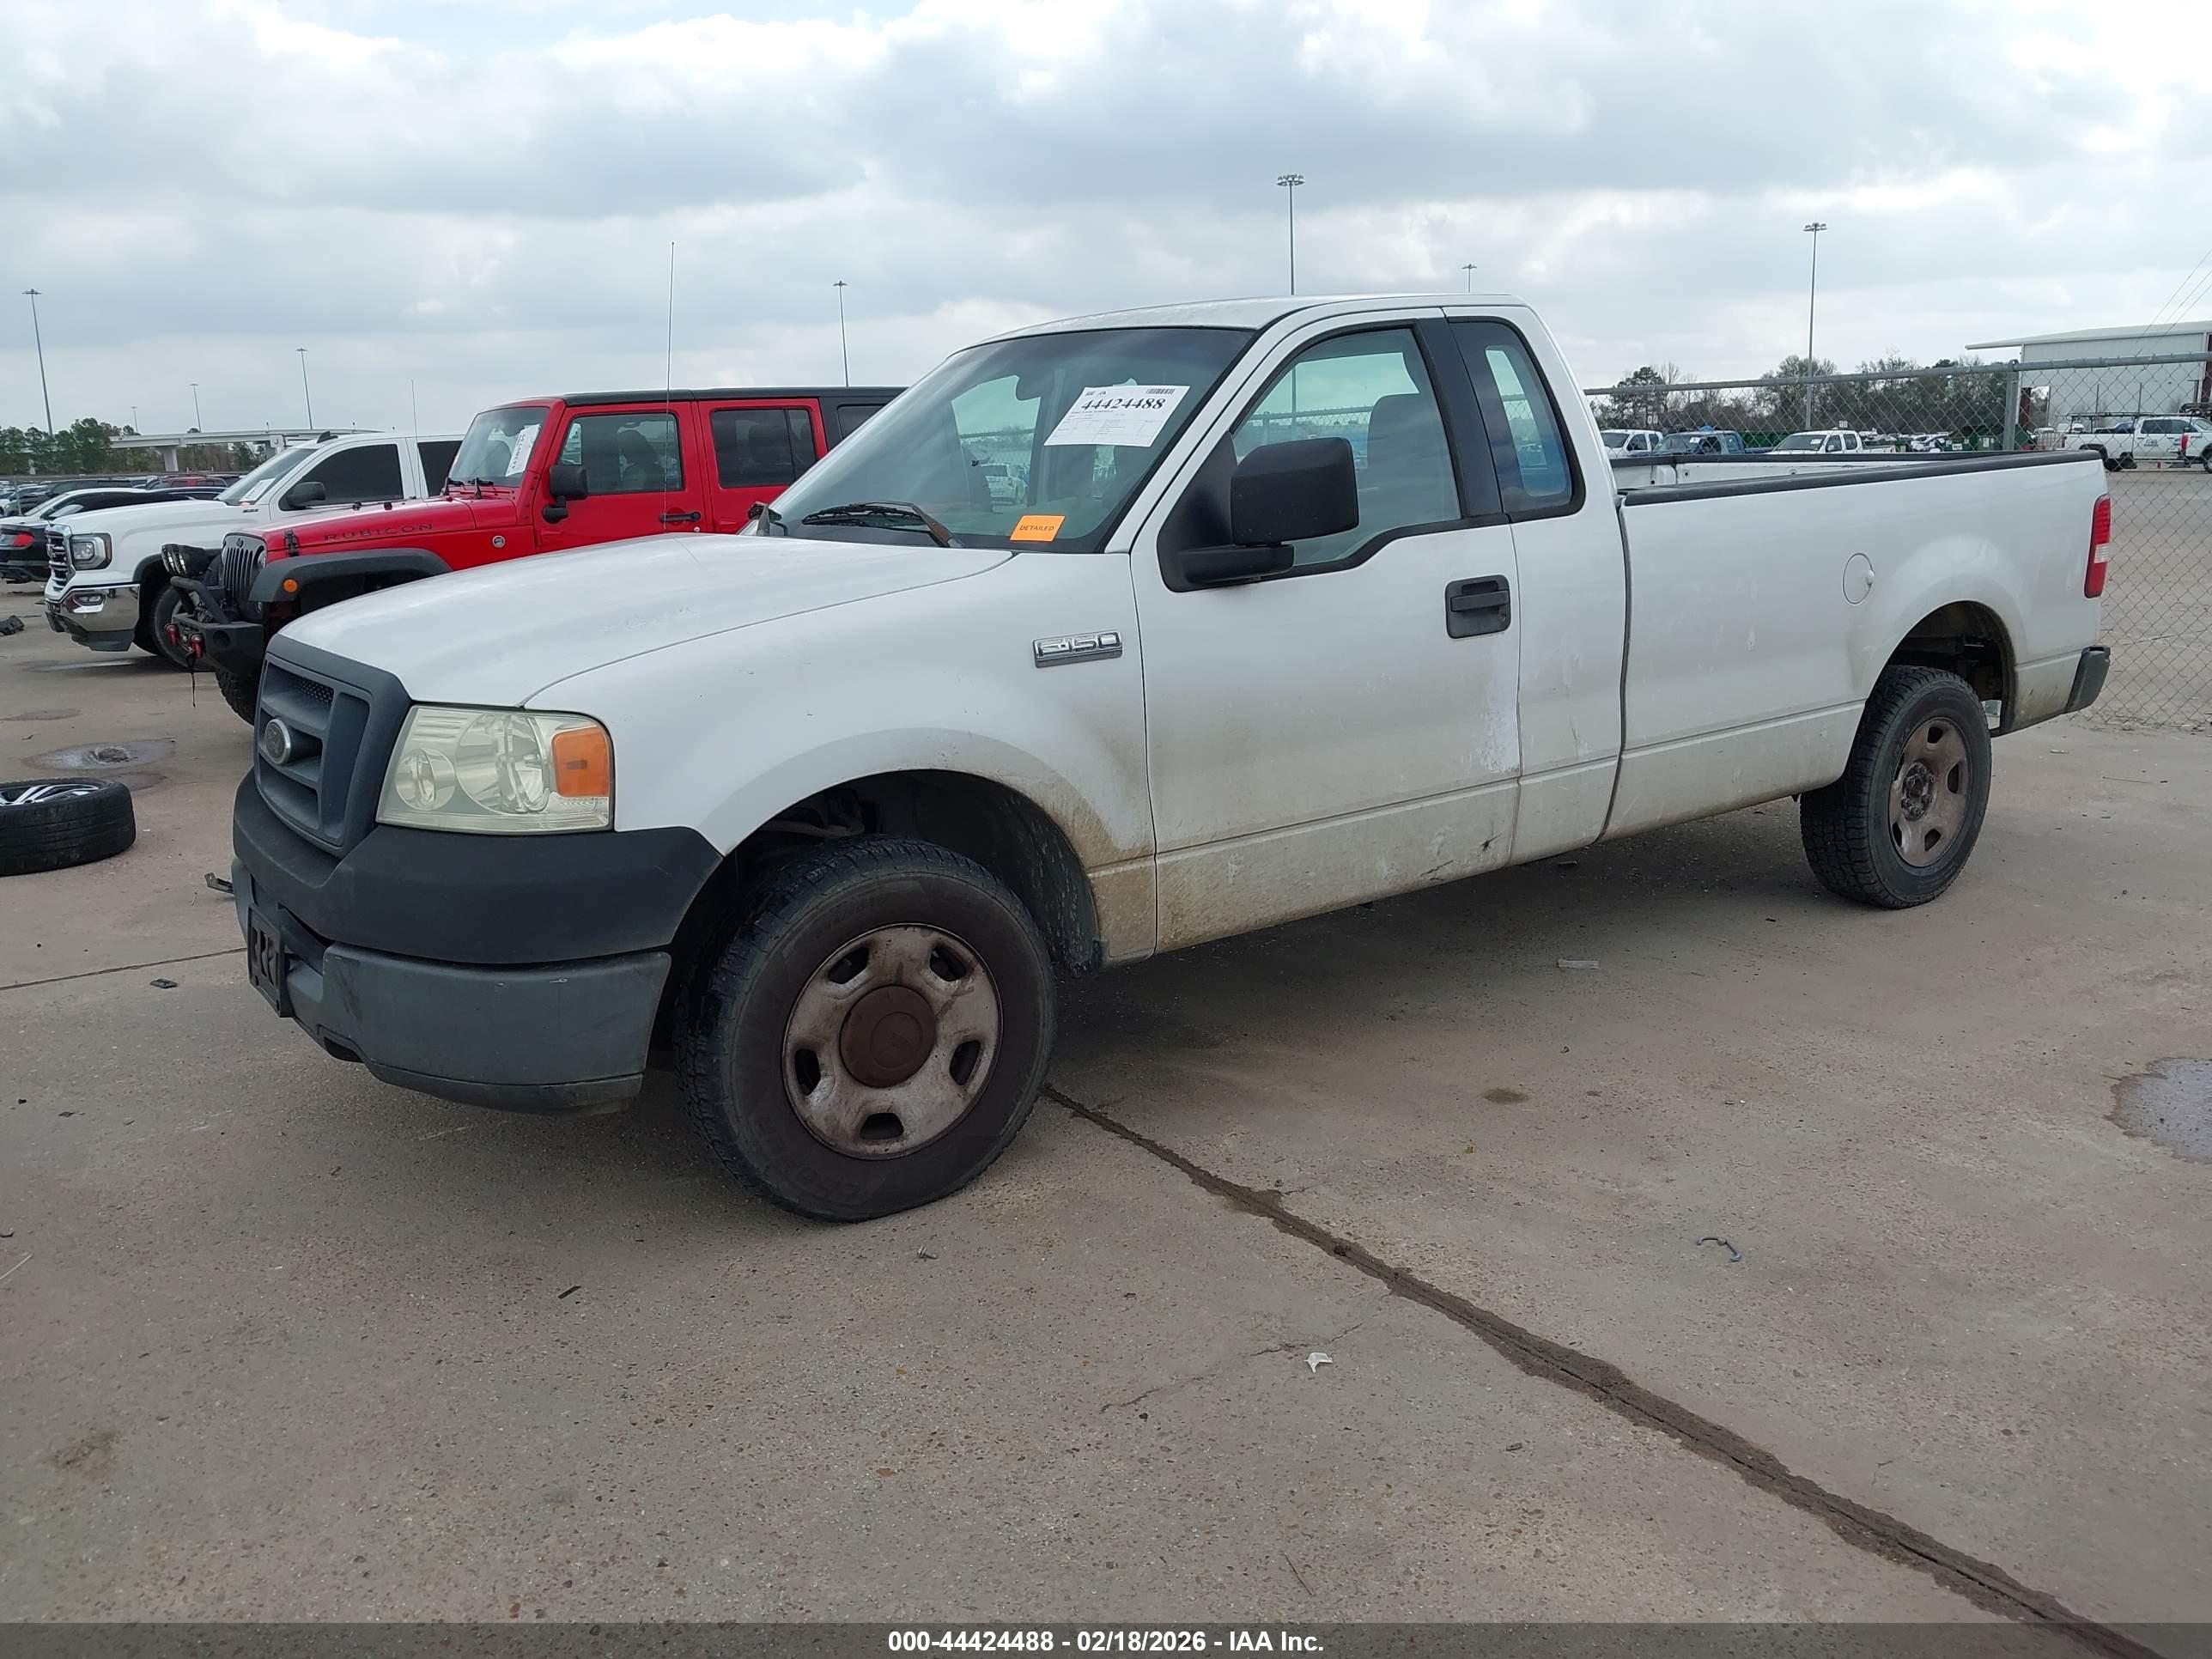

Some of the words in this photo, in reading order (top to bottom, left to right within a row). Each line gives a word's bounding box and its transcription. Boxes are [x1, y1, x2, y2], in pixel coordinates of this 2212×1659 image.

[1081, 398, 1166, 410] 44424488
[324, 523, 434, 541] RUBICON
[1036, 631, 1121, 658] F-150
